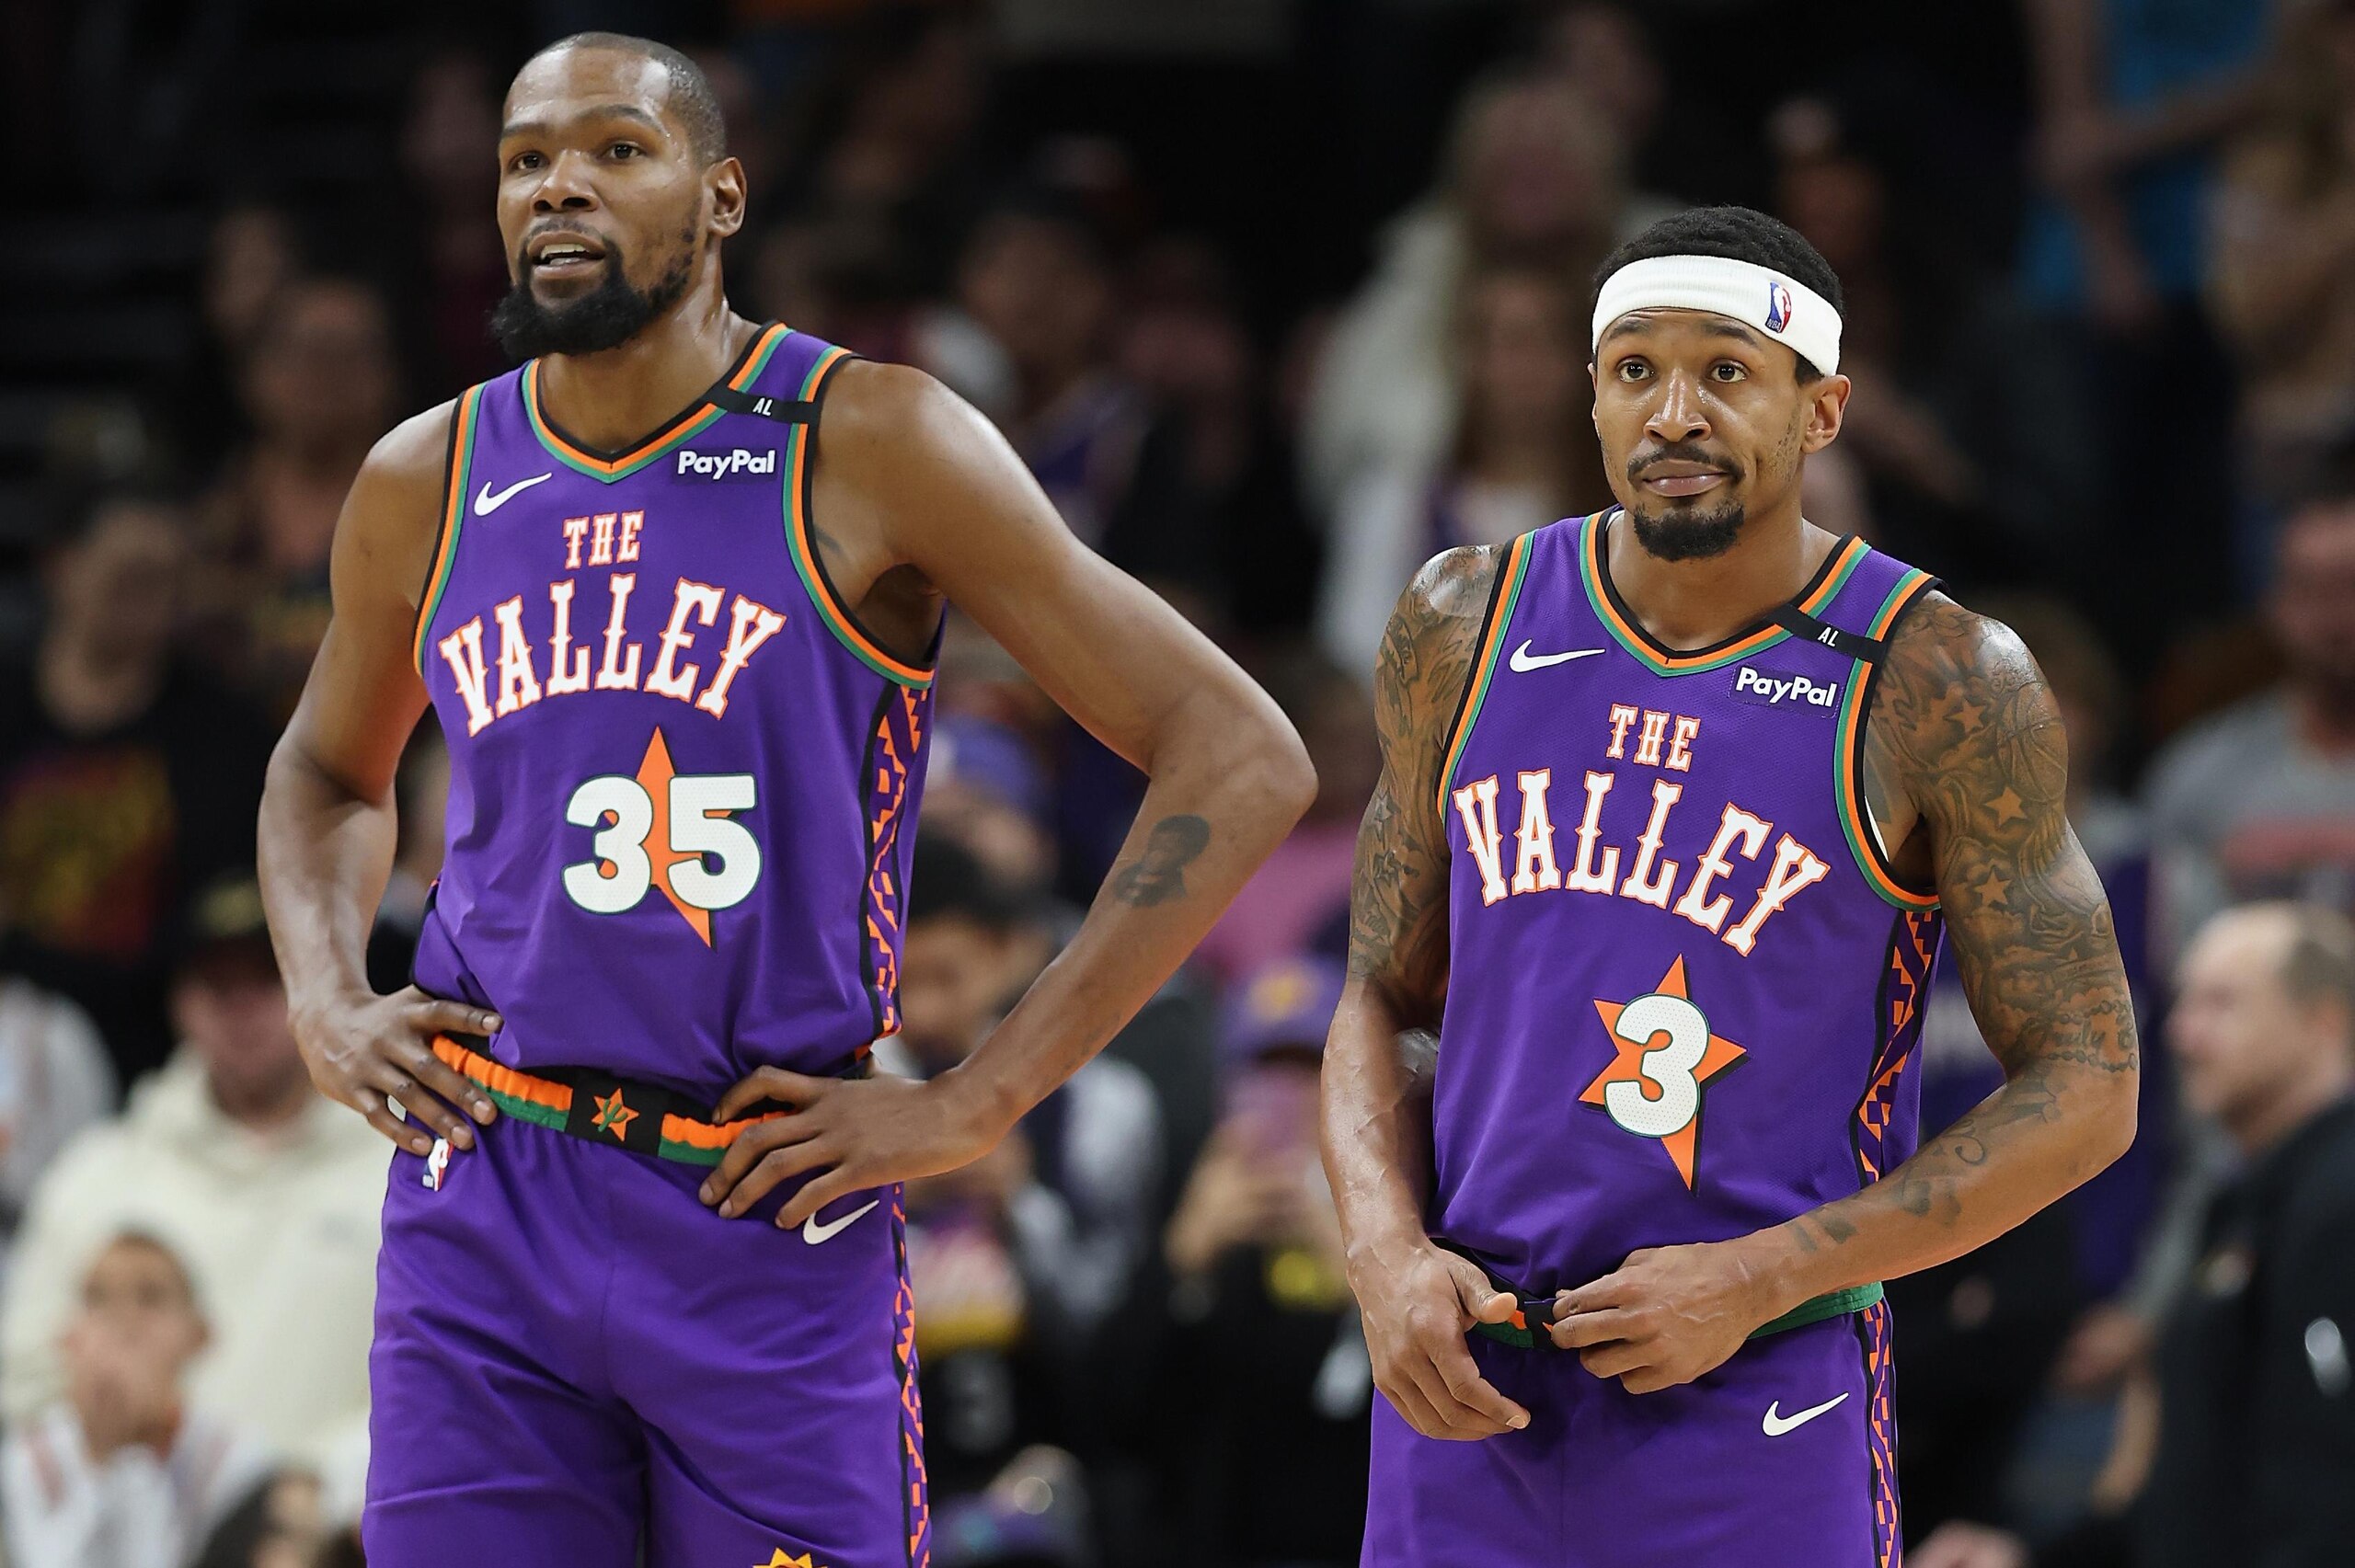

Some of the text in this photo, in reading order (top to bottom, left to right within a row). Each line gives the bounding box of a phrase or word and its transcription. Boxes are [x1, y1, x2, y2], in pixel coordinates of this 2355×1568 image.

[1766, 318, 1781, 333] NBA
[752, 397, 773, 417] AL
[677, 449, 775, 480] PayPal
[563, 510, 644, 569] THE
[439, 573, 787, 738] VALLEY
[1817, 626, 1839, 647] AL
[1735, 667, 1838, 707] PayPal
[1605, 704, 1701, 772] THE
[563, 773, 763, 915] 35
[1453, 769, 1831, 956] VALLEY
[1604, 993, 1709, 1138] 3
